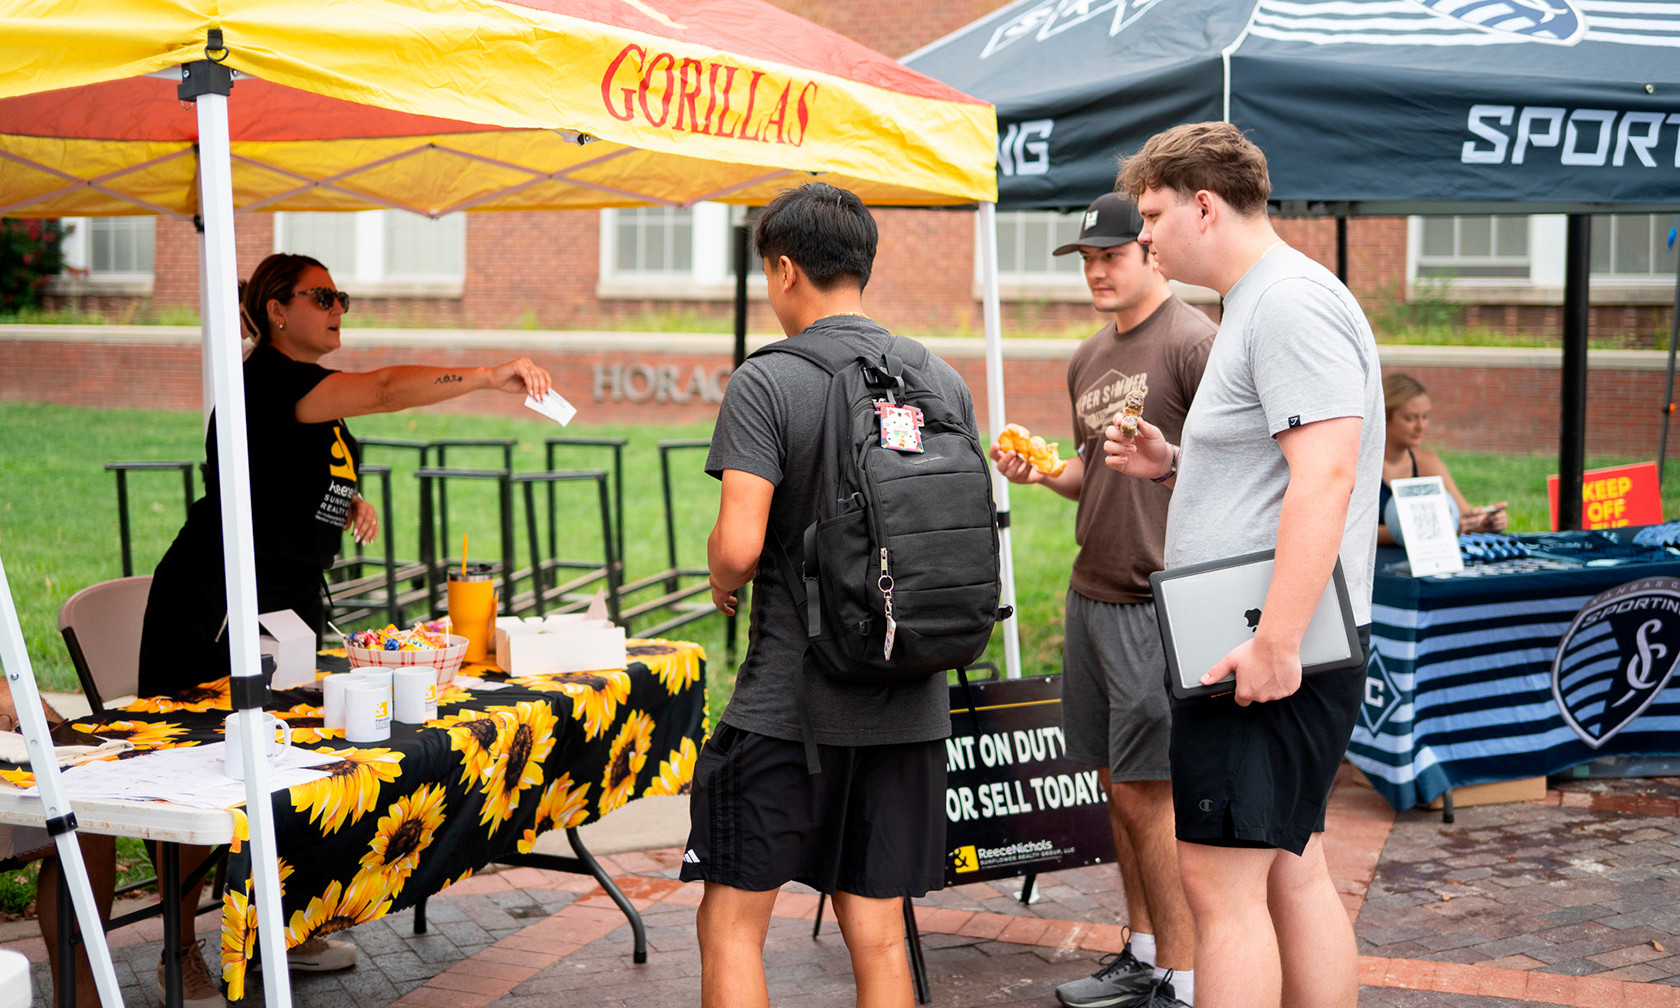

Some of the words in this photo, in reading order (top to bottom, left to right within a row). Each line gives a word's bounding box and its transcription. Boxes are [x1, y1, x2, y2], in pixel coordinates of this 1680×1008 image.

[601, 43, 818, 147] GORILLAS
[1582, 476, 1632, 502] KEEP
[1587, 499, 1626, 522] OFF
[1590, 581, 1663, 606] KANSAS
[1581, 597, 1680, 628] SPORTIN
[945, 736, 976, 772] NT
[979, 732, 1014, 768] ON
[978, 780, 1033, 818] SELL
[977, 839, 1053, 859] ReeceNichols
[980, 855, 1017, 866] SUNFLOWER
[1018, 852, 1040, 861] REALTY
